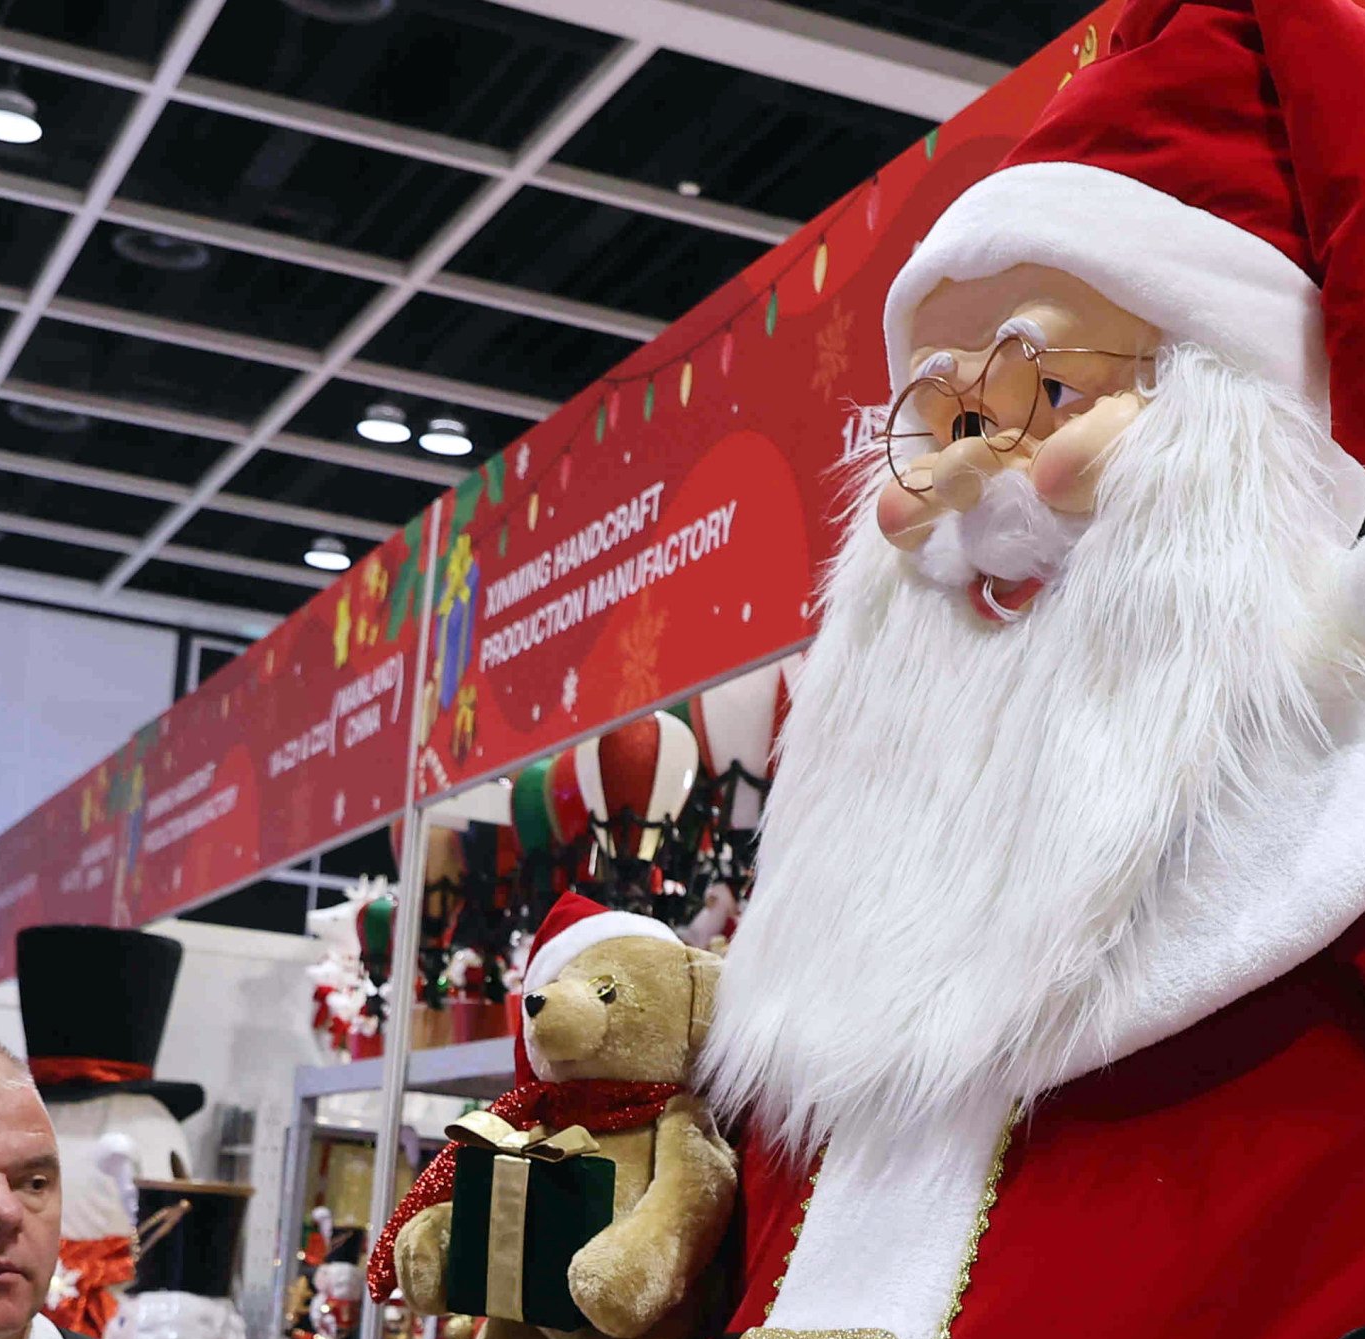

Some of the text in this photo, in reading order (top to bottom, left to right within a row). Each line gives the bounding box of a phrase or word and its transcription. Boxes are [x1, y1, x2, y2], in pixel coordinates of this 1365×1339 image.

[479, 499, 737, 674] PRODUCTION MANUFACTORY
[484, 480, 665, 620] XINMING HANDCRAFT
